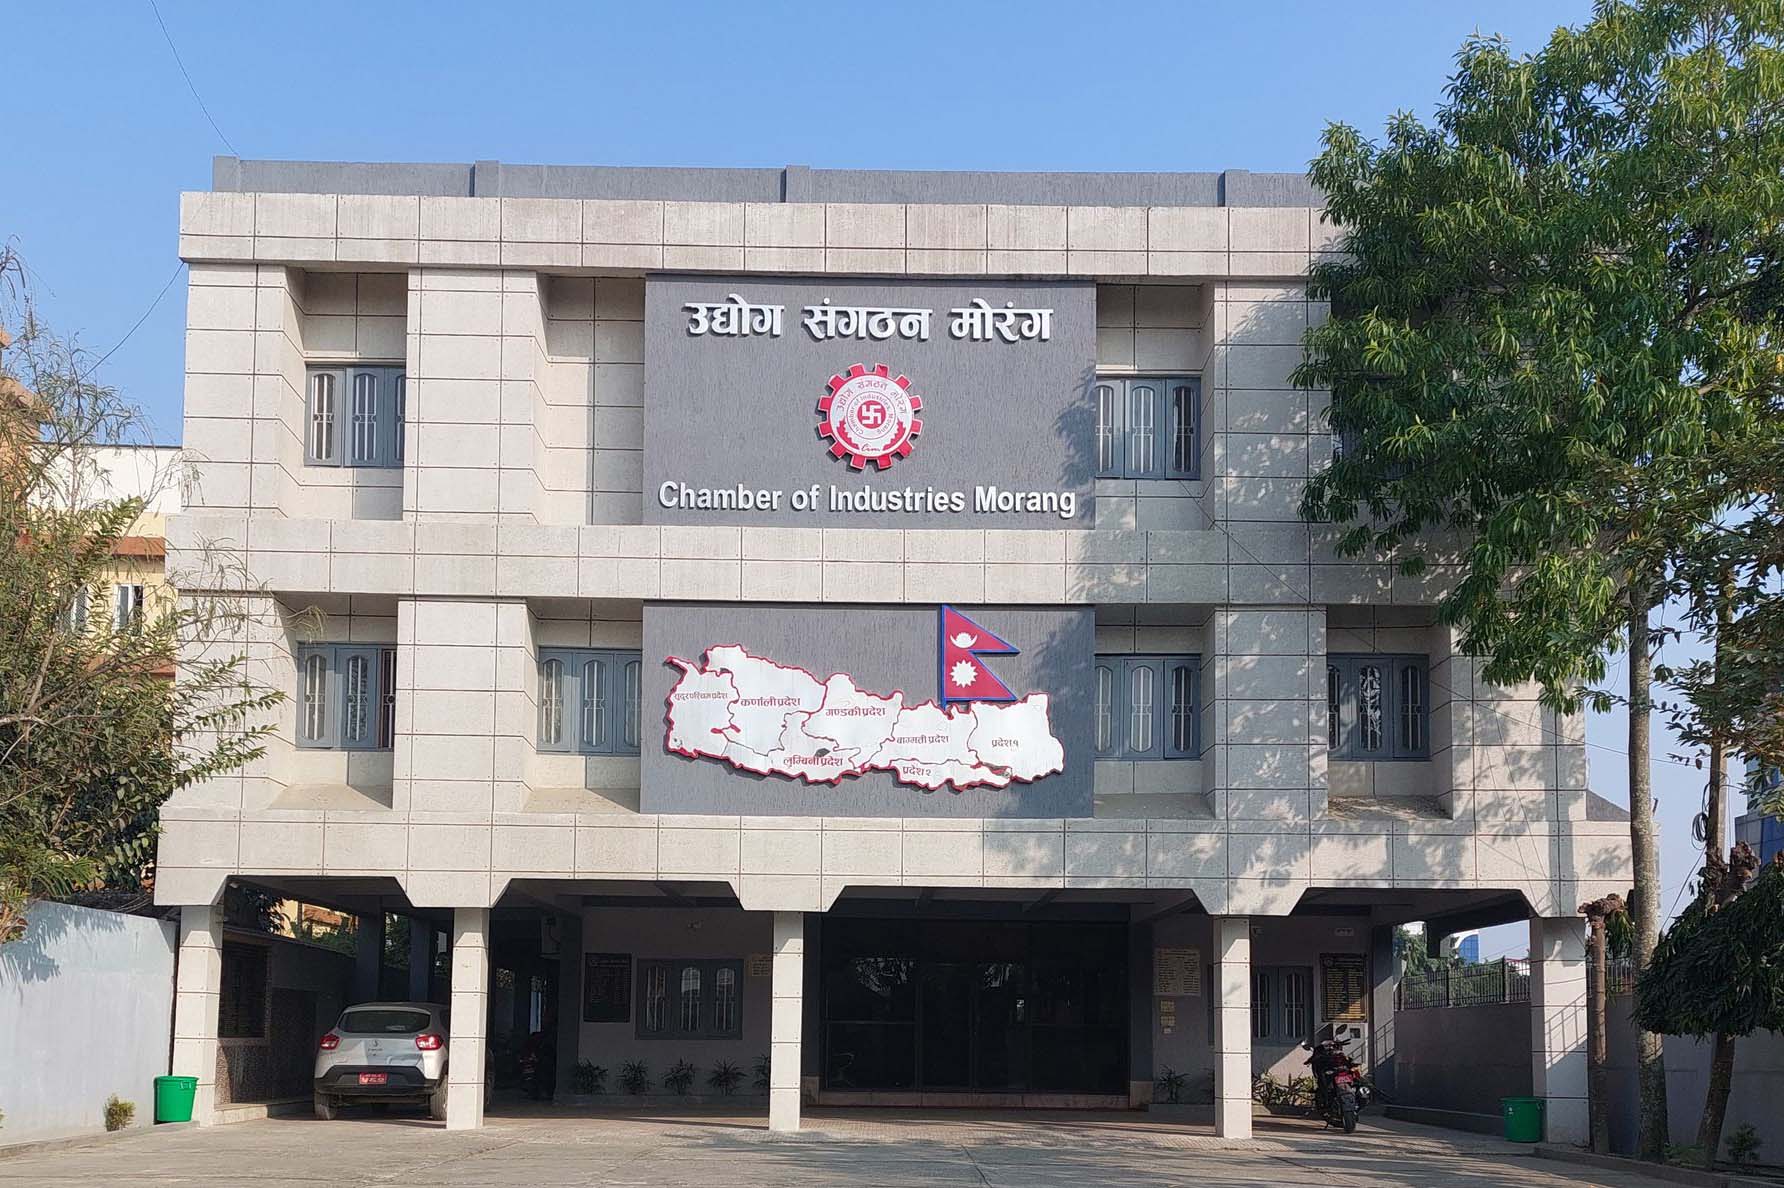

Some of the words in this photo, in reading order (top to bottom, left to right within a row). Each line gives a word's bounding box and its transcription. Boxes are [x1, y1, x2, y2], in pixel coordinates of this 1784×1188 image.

[685, 293, 785, 336] उद्योग
[803, 296, 933, 340] संगठन
[950, 297, 1054, 342] मोरंग
[659, 480, 783, 510] Chamber
[791, 484, 821, 511] of
[829, 484, 966, 513] Industries
[973, 485, 1076, 519] Morang
[928, 733, 949, 745] प्रदेश
[902, 764, 925, 776] प्रदेश
